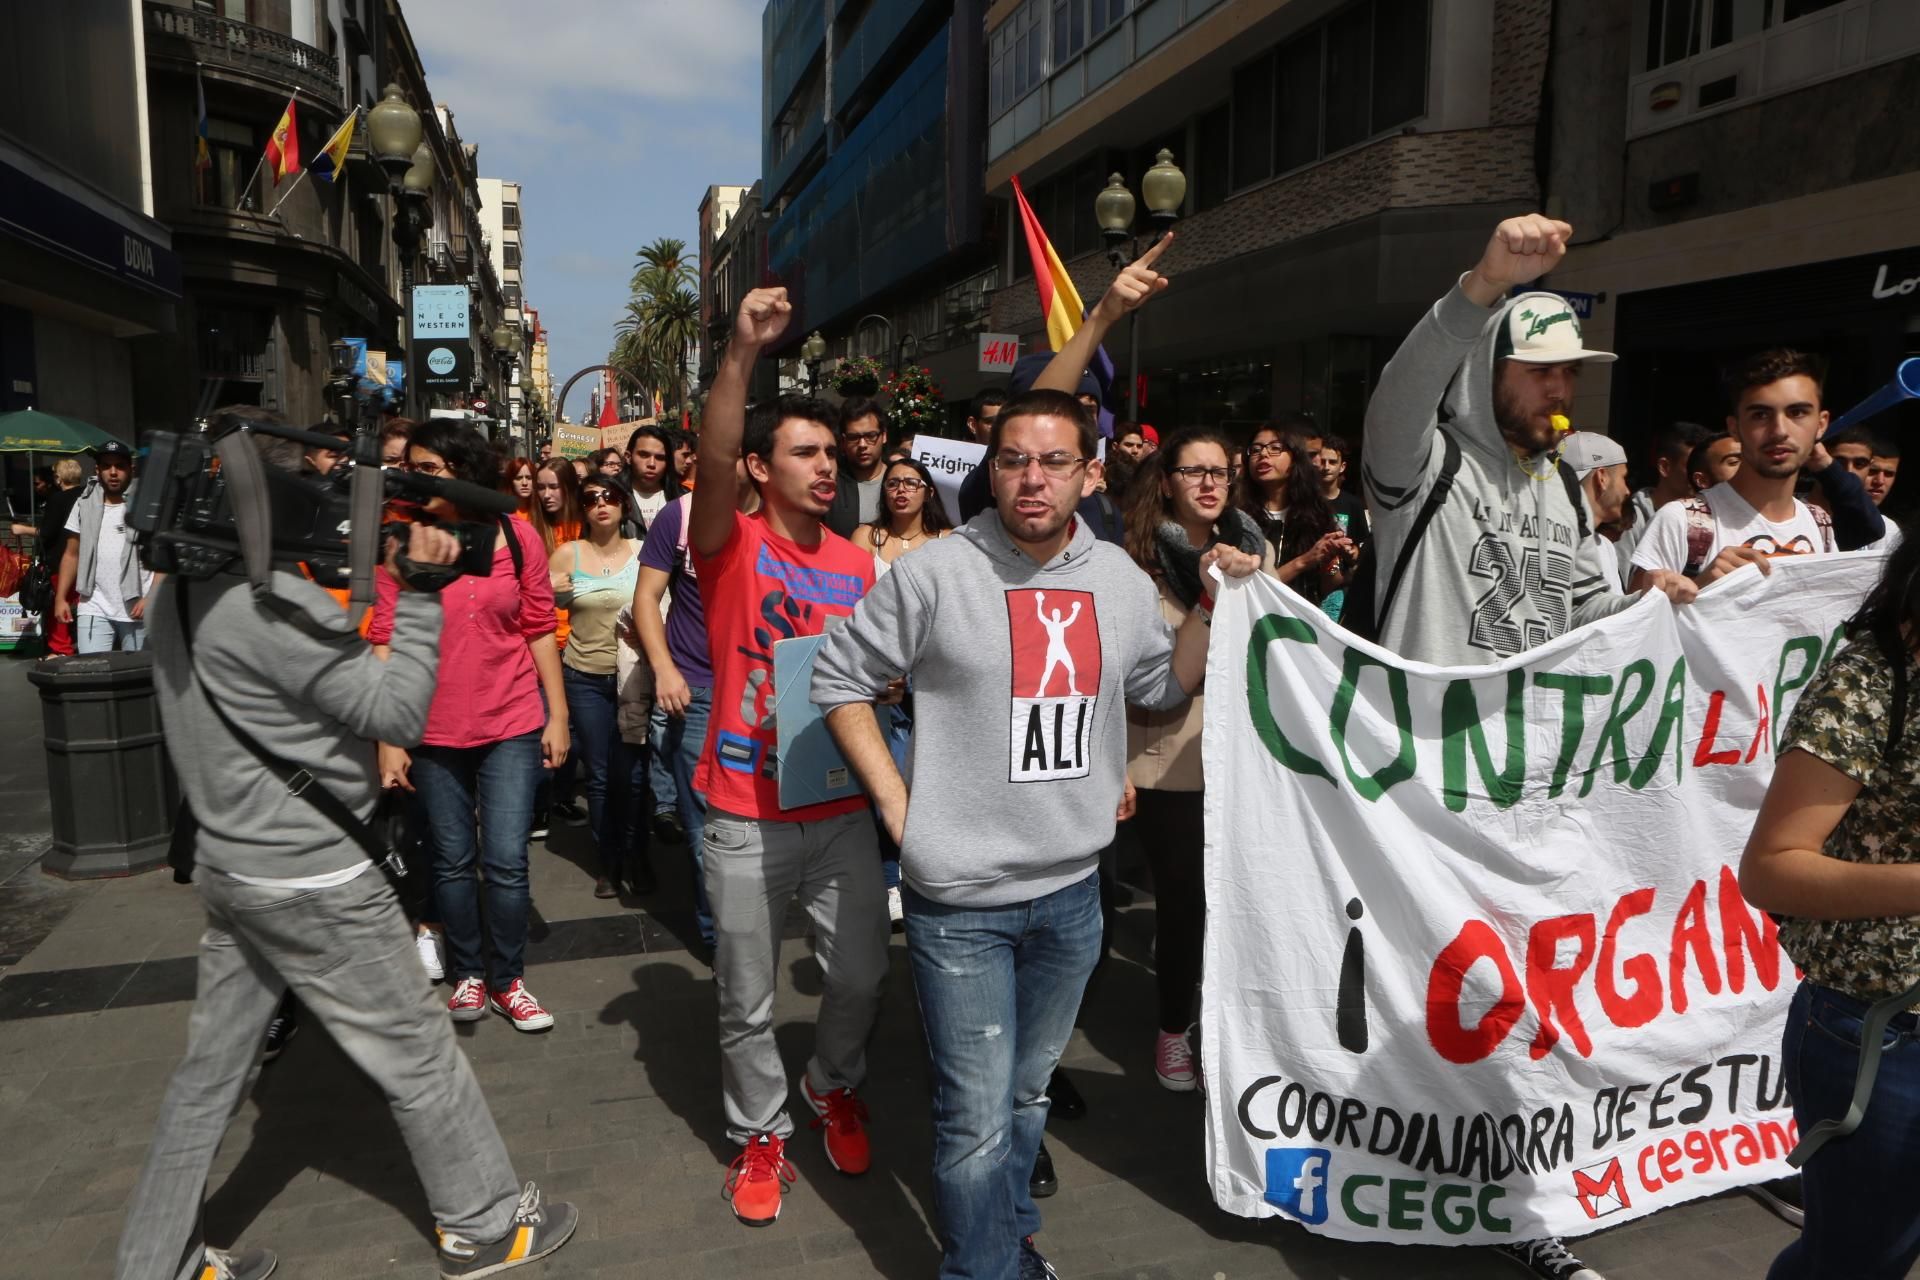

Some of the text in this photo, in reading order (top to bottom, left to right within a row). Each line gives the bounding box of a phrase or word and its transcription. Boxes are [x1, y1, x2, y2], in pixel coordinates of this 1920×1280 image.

[124, 235, 154, 277] BBVA
[1872, 264, 1920, 299] Lo
[418, 303, 464, 311] CICLO
[983, 340, 1017, 365] H&M
[920, 452, 977, 474] Exigim
[1468, 532, 1572, 658] 25
[1022, 704, 1087, 771] ALI
[1246, 613, 1686, 813] CONTRA
[1693, 682, 1769, 767] LA
[1426, 864, 1804, 1064] ORGAN
[1238, 1075, 1575, 1183] COORDINADORA
[1648, 1053, 1793, 1130] ESTU
[1341, 1174, 1512, 1235] CEGC
